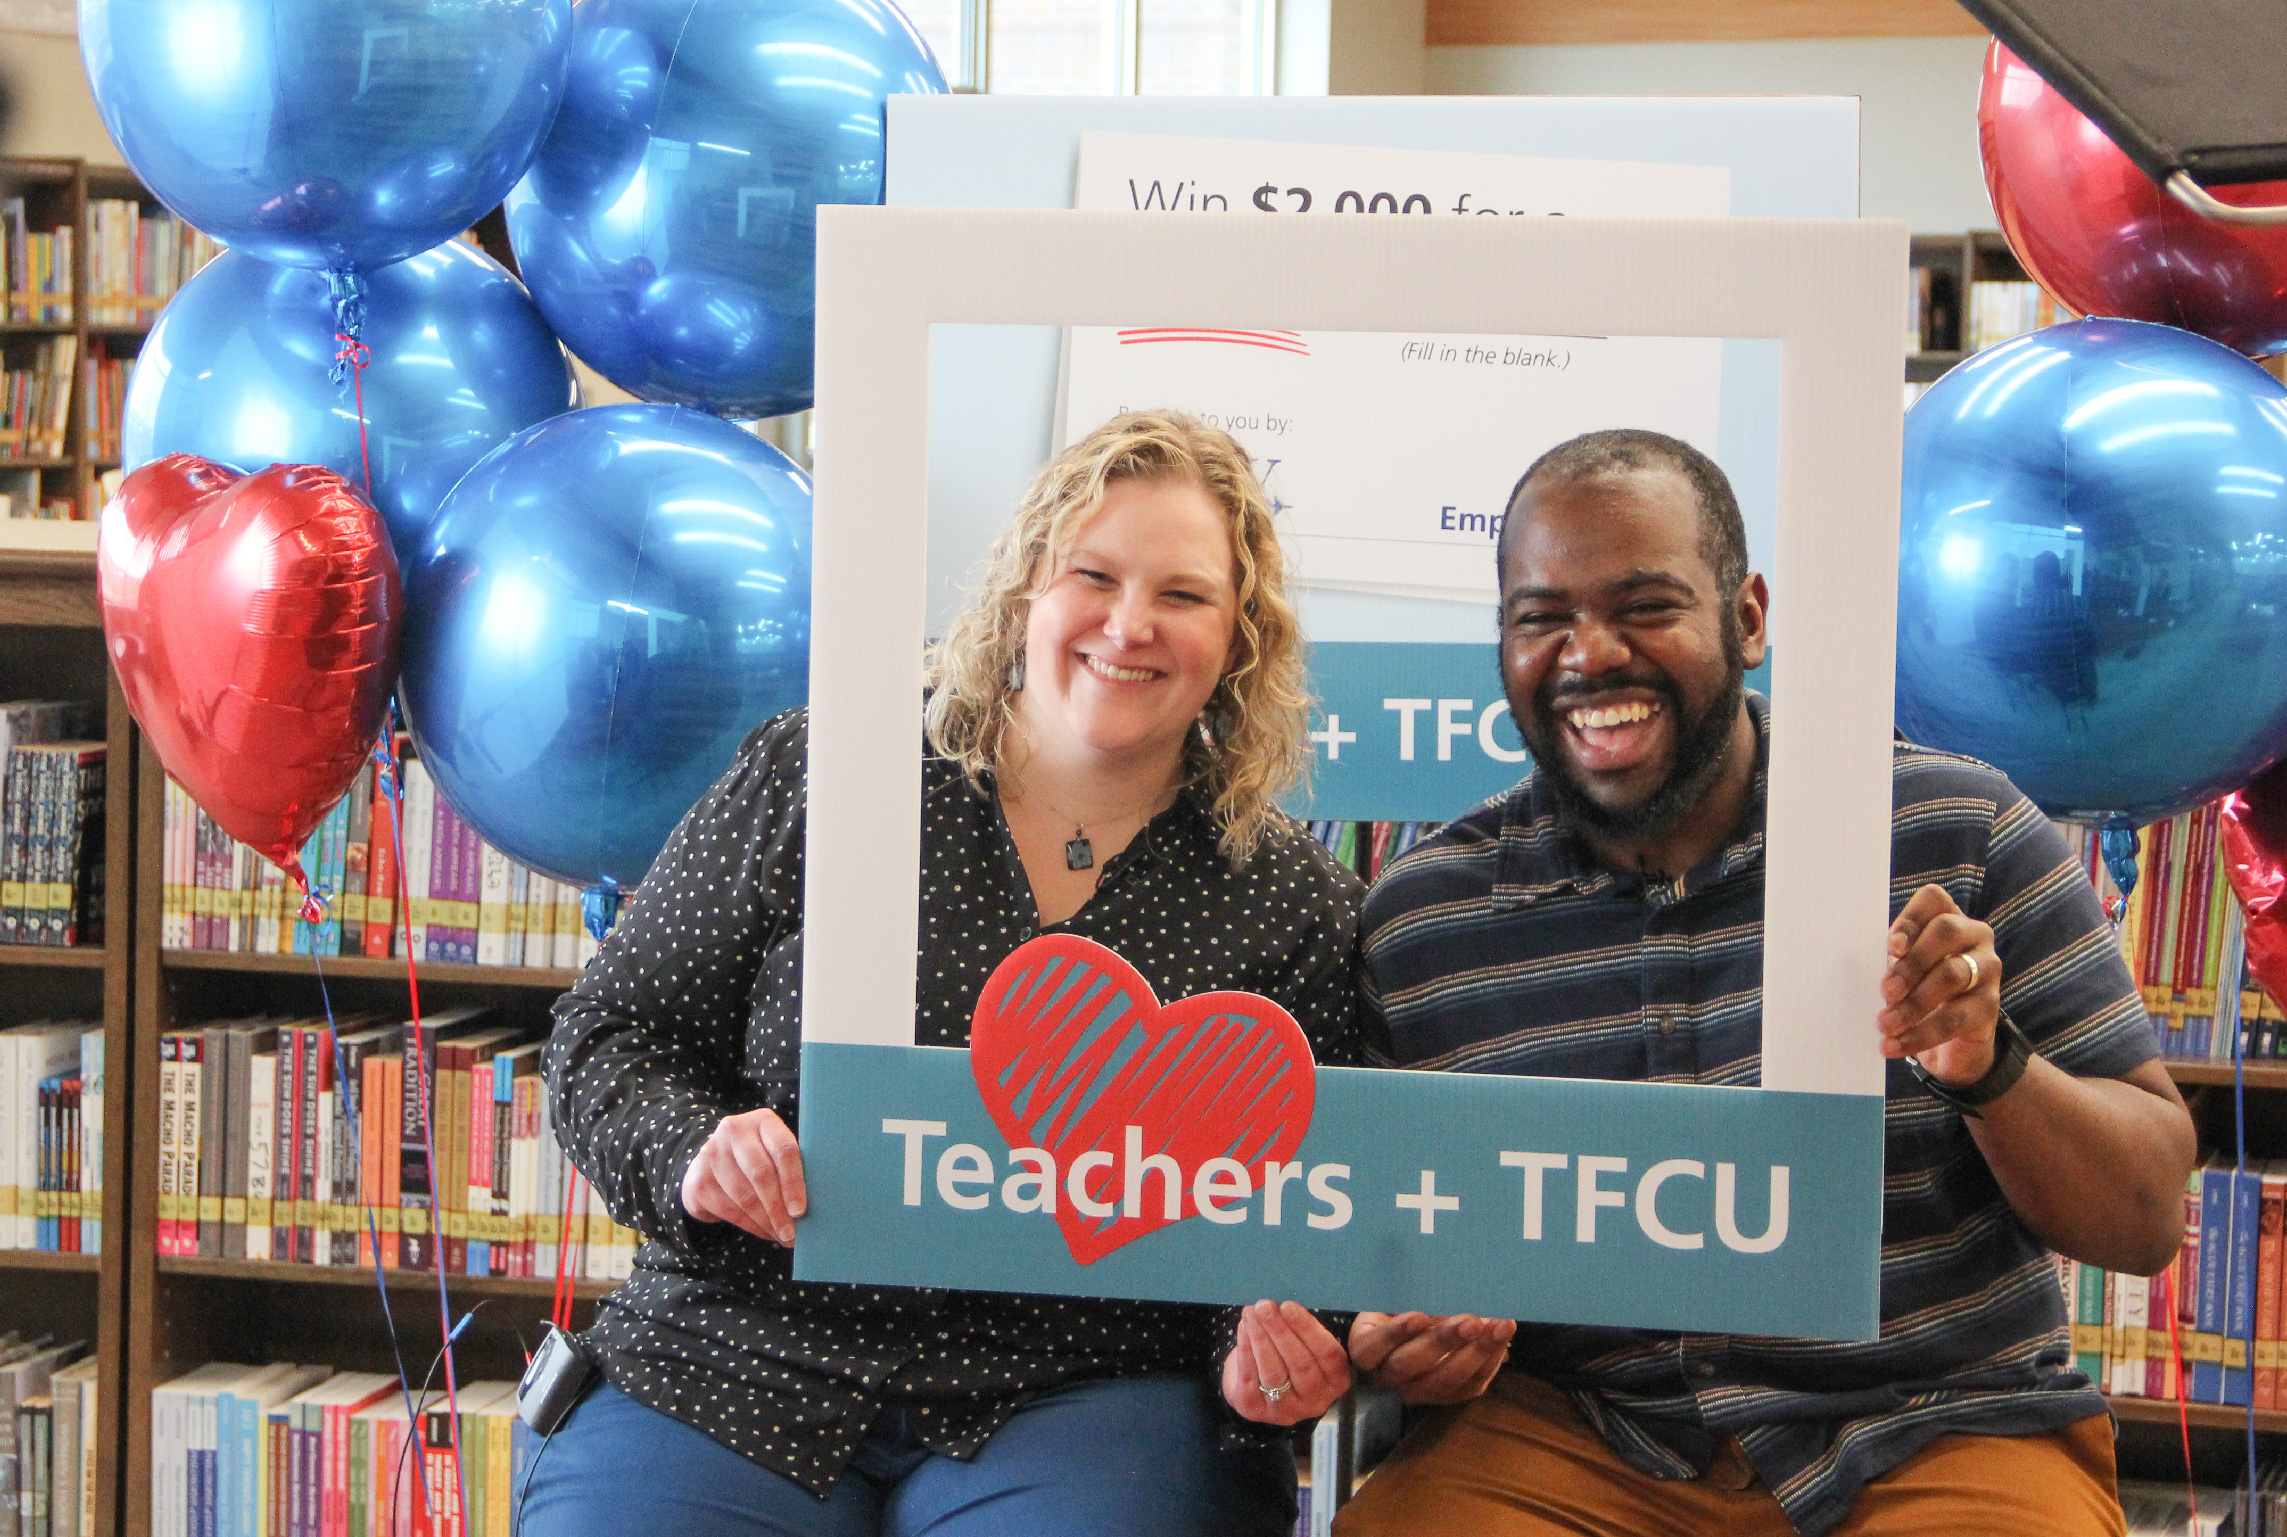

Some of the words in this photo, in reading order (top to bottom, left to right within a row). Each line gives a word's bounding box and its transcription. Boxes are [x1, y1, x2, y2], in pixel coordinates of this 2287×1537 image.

[1129, 178, 1229, 212] Win
[1401, 340, 1435, 362] (Fill
[1439, 343, 1458, 363] in
[1465, 345, 1497, 365] the
[1502, 347, 1571, 370] blank.)
[1226, 414, 1259, 433] you
[1267, 413, 1293, 436] by:
[1383, 698, 1527, 763] TFC
[283, 1048, 293, 1072] THE
[308, 1049, 318, 1072] THE
[164, 1072, 175, 1094] THE
[184, 1073, 196, 1095] THE
[282, 1074, 292, 1099] SUN
[307, 1075, 317, 1100] SUN
[405, 1037, 418, 1136] TRADITION
[163, 1101, 176, 1146] MACHO
[183, 1102, 196, 1147] MACHO
[281, 1100, 291, 1135] DOES
[305, 1101, 316, 1135] DOES
[162, 1151, 175, 1195] PARAD
[248, 1142, 269, 1170] 57
[280, 1138, 291, 1175] SHINE
[304, 1138, 315, 1175] SHINE
[882, 1117, 1354, 1233] Teachers
[1395, 1169, 1460, 1235] +
[1499, 1150, 1791, 1254] TFCU
